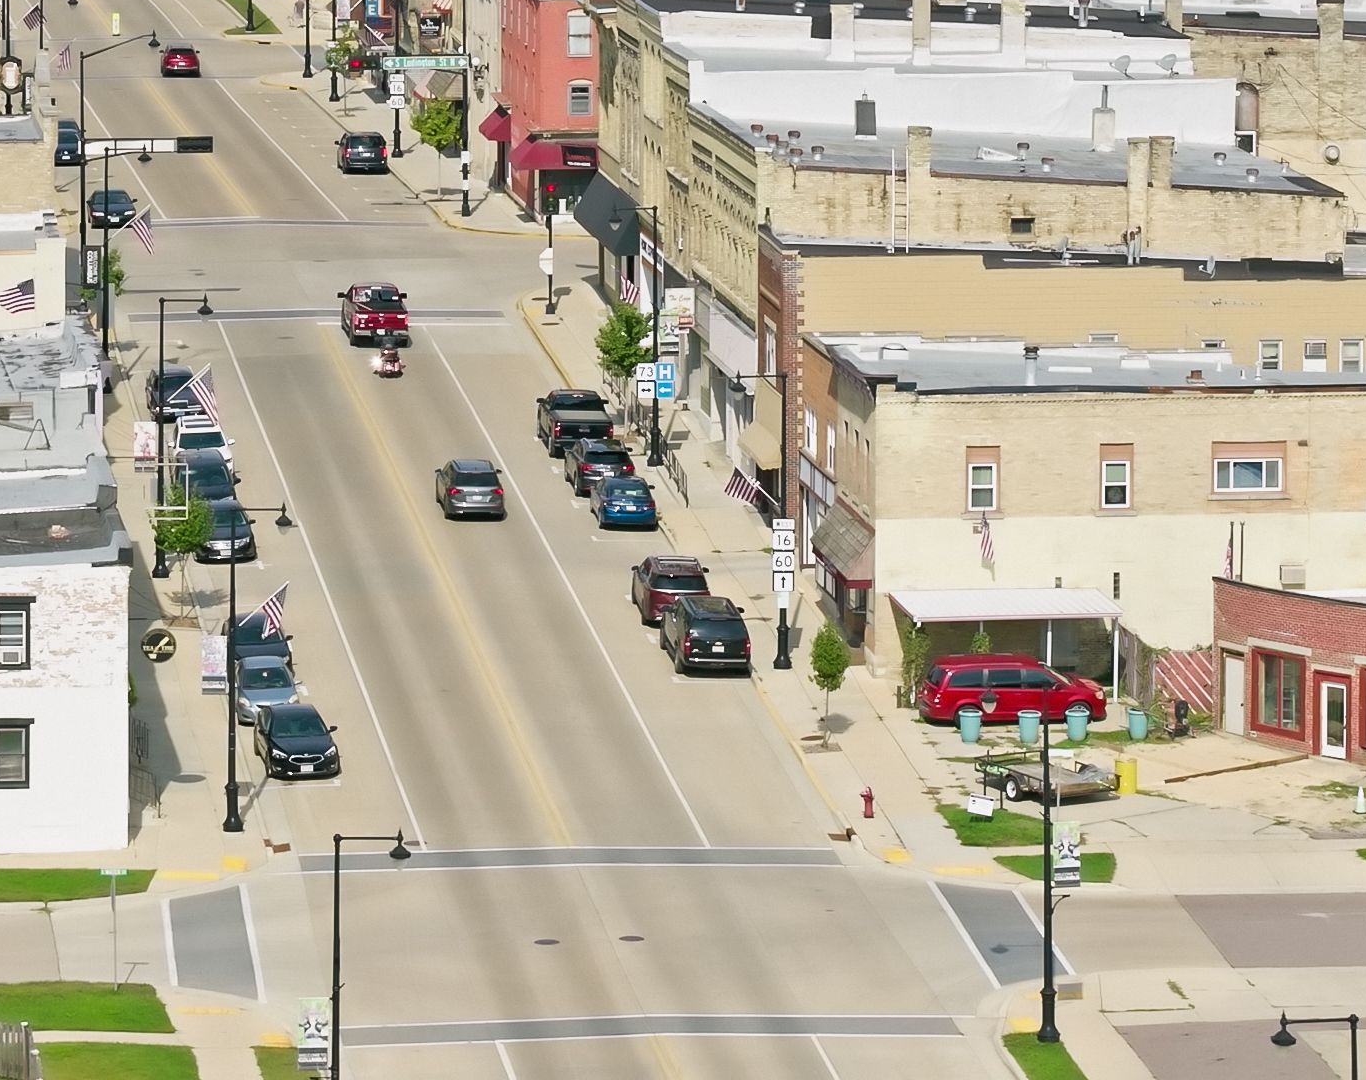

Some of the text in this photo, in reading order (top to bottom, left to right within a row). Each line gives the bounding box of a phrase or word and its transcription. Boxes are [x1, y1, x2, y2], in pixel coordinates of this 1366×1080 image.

[392, 84, 403, 92] 16
[391, 97, 404, 106] 60
[638, 365, 671, 379] 73 H
[777, 534, 791, 546] 16
[775, 555, 793, 568] 60
